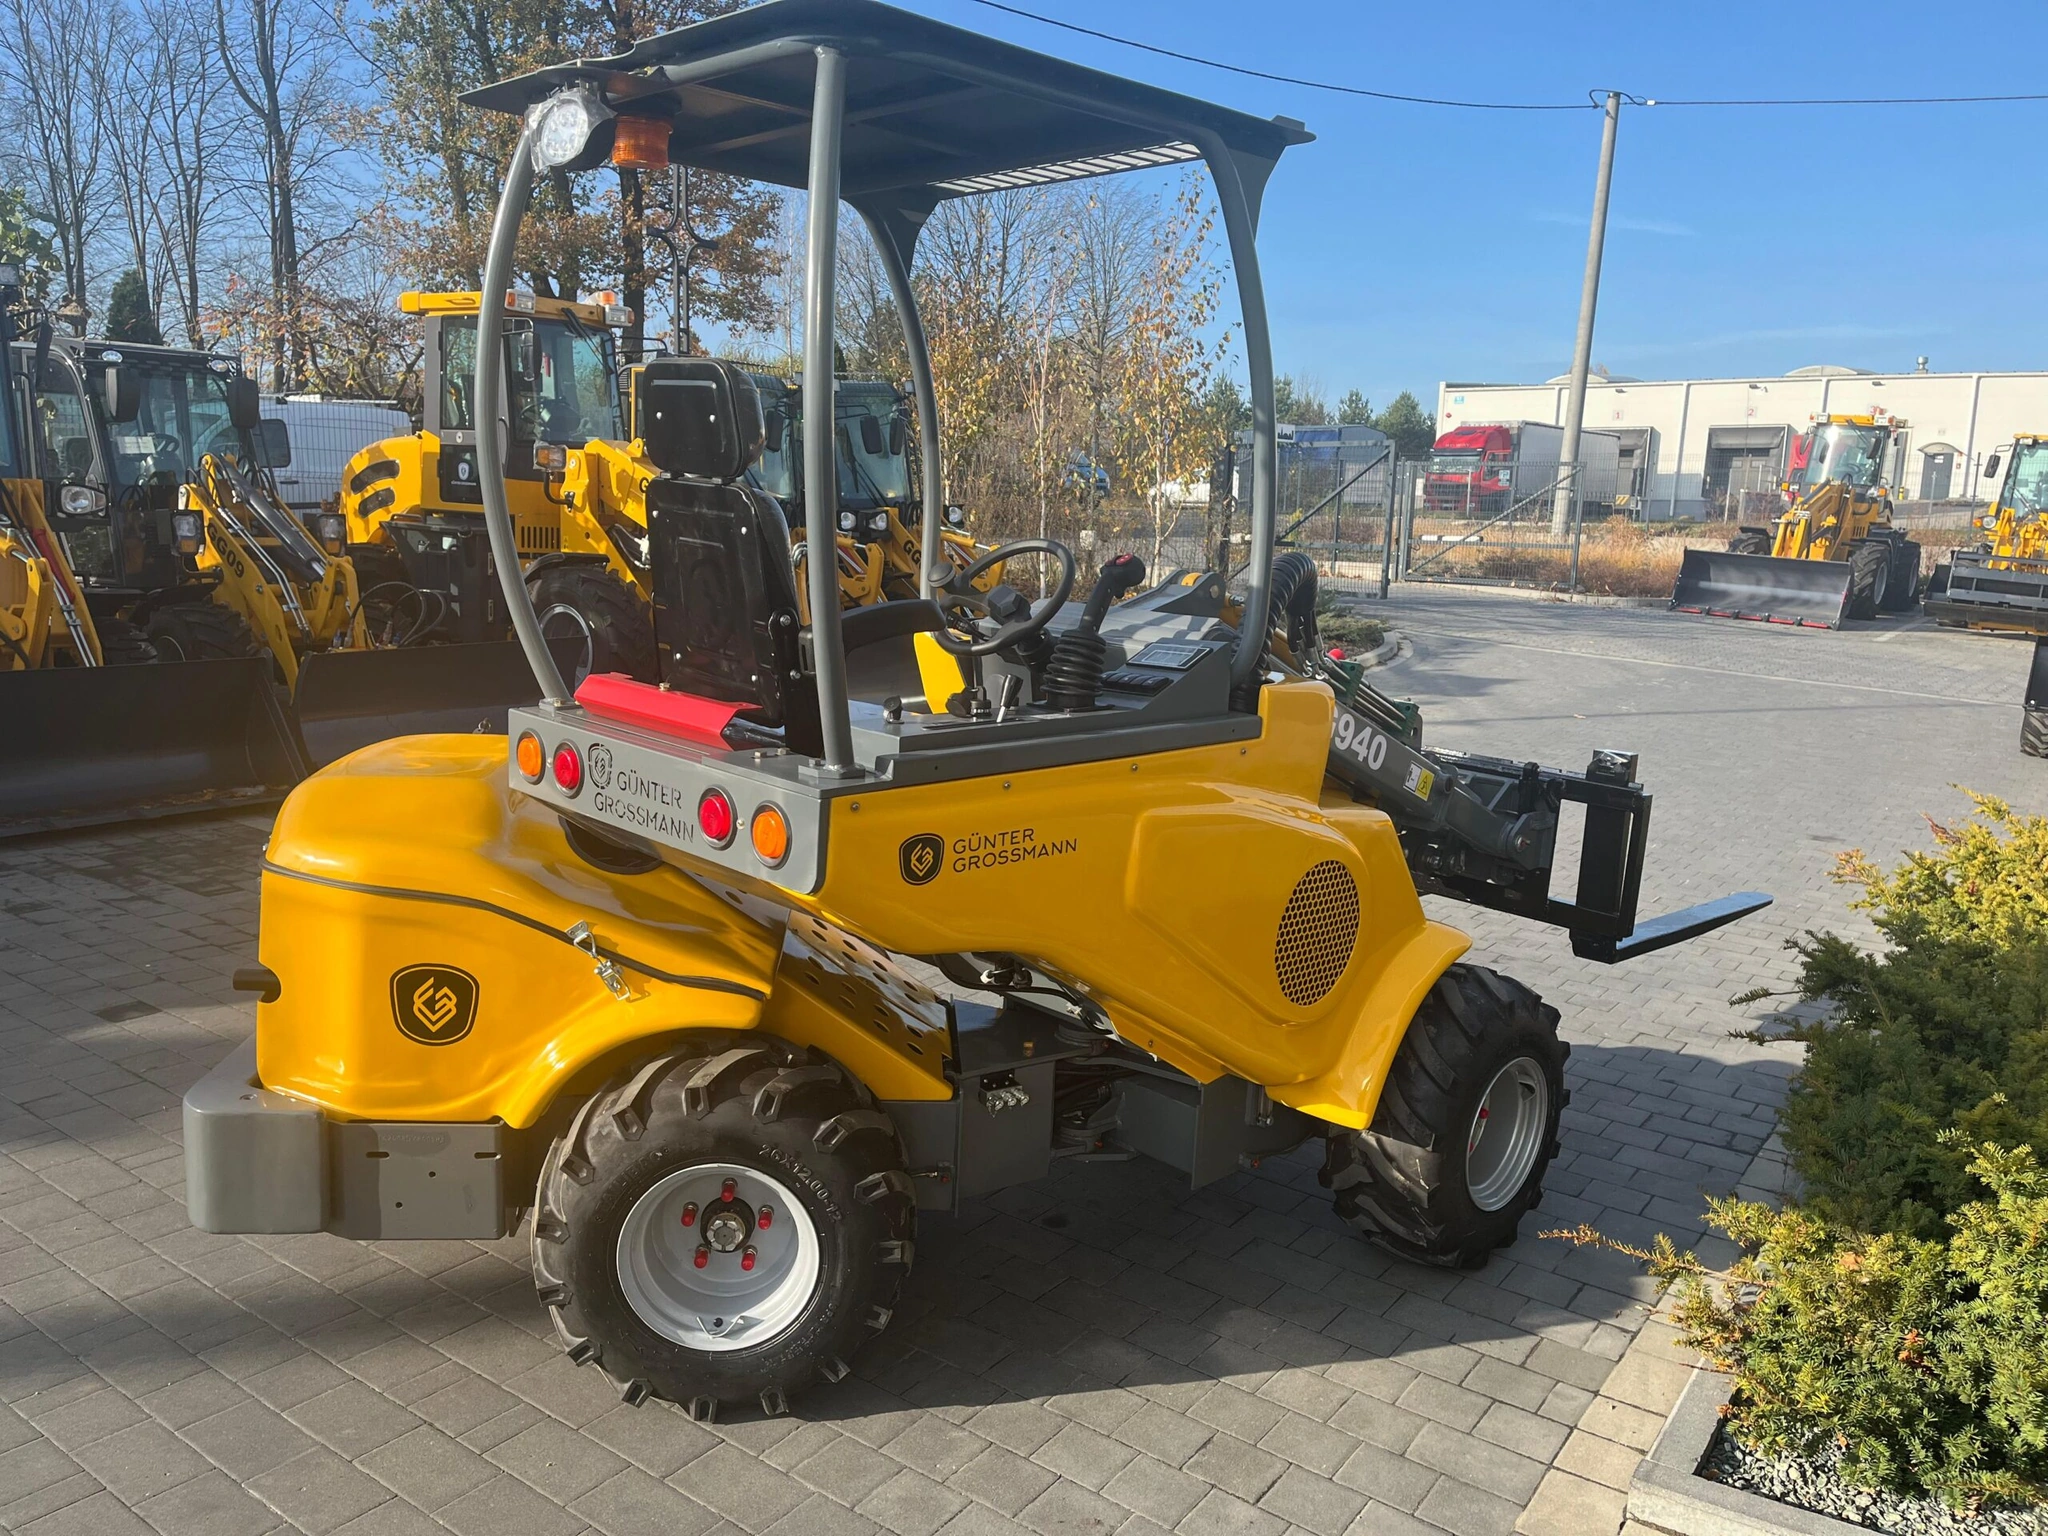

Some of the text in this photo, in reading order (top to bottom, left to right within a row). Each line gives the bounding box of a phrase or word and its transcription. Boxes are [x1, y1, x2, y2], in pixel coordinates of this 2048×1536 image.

[1747, 408, 1754, 416] 2
[208, 522, 244, 578] GG09
[617, 769, 682, 809] GÜNTER
[594, 792, 694, 843] GROSSMANN
[953, 828, 1034, 854] GÜNTER
[953, 838, 1077, 873] GROSSMANN
